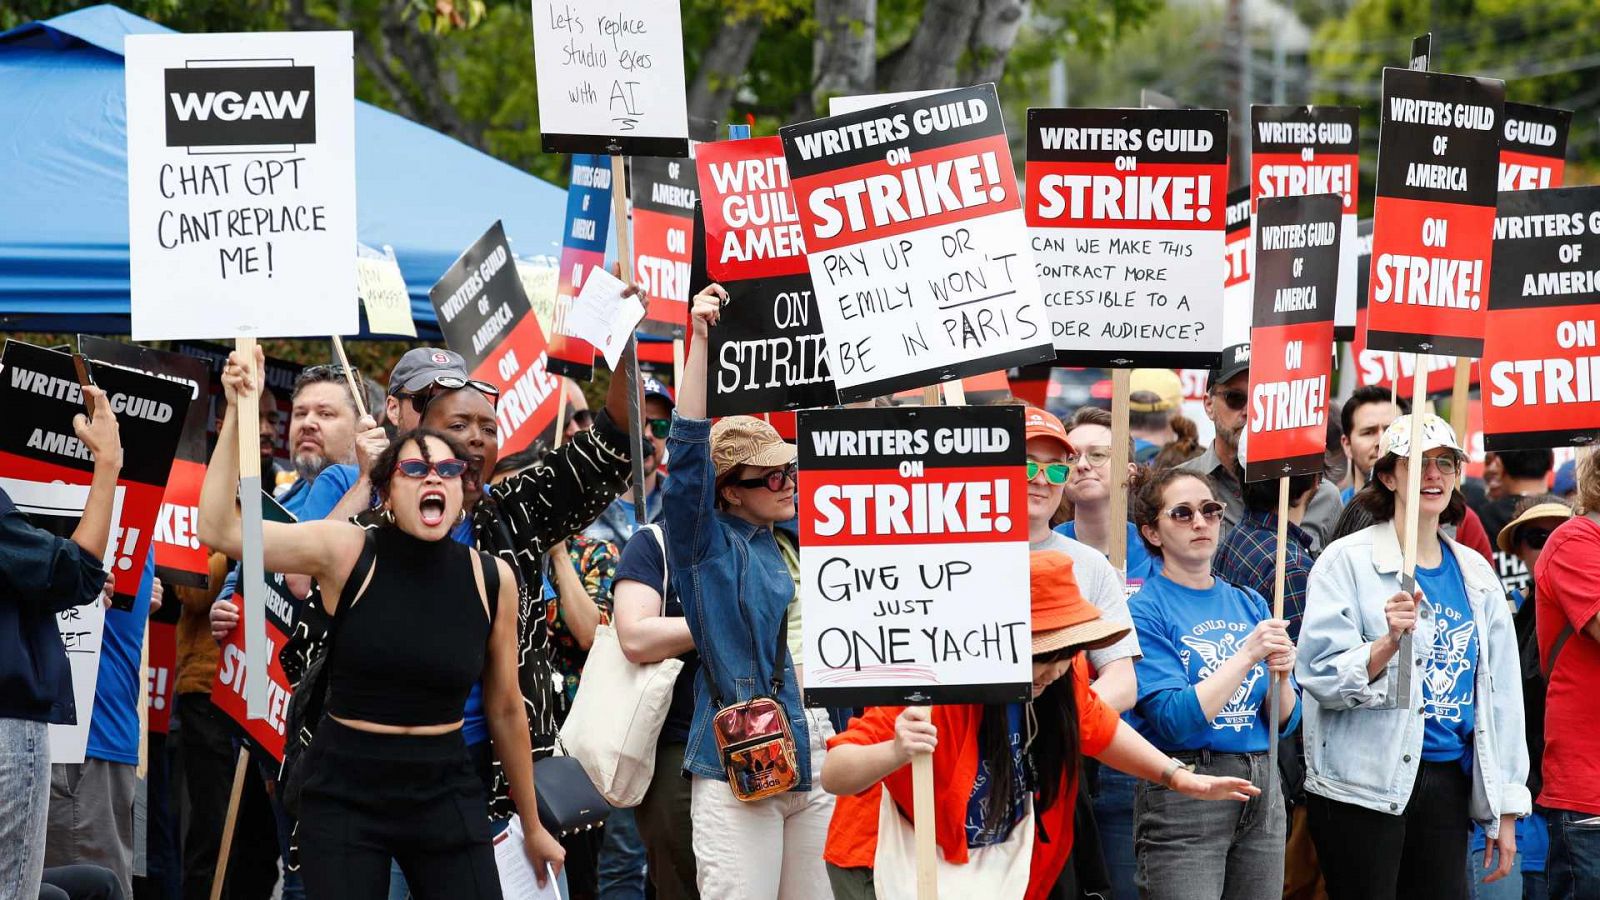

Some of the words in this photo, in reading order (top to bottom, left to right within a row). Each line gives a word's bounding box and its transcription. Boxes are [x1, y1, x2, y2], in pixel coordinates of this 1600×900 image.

[598, 12, 647, 52] replace
[170, 90, 310, 121] WGAW
[569, 80, 597, 104] with
[609, 79, 644, 115] AI
[1390, 97, 1451, 128] WRITERS
[1454, 103, 1495, 131] GUILD
[795, 114, 907, 161] WRITERS
[913, 98, 988, 135] GUILD
[1040, 127, 1142, 151] WRITERS
[1146, 129, 1213, 152] GUILD
[1258, 122, 1317, 143] WRITERS
[1318, 123, 1352, 144] GUILD
[1504, 119, 1557, 147] GUILD
[886, 146, 911, 166] ON
[1301, 147, 1314, 162] ON
[1433, 136, 1447, 156] OF
[159, 163, 232, 199] CHAT
[244, 158, 306, 196] GPT
[668, 162, 680, 180] OF
[709, 157, 789, 194] WRIT
[1115, 156, 1136, 171] ON
[1405, 162, 1467, 192] AMERICA
[652, 182, 696, 209] AMERICA
[722, 191, 799, 229] GUIL
[808, 151, 1006, 239] STRIKE!
[1038, 174, 1212, 223] STRIKE!
[667, 228, 685, 254] ON
[720, 225, 808, 264] AMER
[1032, 236, 1065, 252] CAN
[1075, 239, 1100, 254] WE
[1108, 240, 1152, 255] MAKE
[1159, 241, 1193, 257] THIS
[1262, 224, 1307, 251] WRITERS
[1307, 222, 1335, 247] GUILD
[1422, 217, 1447, 247] ON
[823, 247, 870, 285] PAY
[883, 240, 913, 271] UP
[942, 228, 975, 258] OR
[1293, 258, 1303, 278] OF
[1559, 244, 1582, 263] OF
[440, 271, 483, 323] WRITERS
[479, 245, 507, 283] GUILD
[839, 282, 913, 320] EMILY
[928, 253, 1017, 302] WON'T
[1124, 266, 1167, 281] MORE
[1374, 253, 1483, 311] STRIKE!
[477, 295, 490, 316] OF
[773, 291, 811, 329] ON
[1044, 290, 1137, 308] CCESSIBLE
[1147, 292, 1168, 307] TO
[1176, 295, 1191, 312] A
[1273, 286, 1317, 313] AMERICA
[471, 302, 513, 355] AMERICA
[839, 337, 876, 376] BE
[902, 322, 928, 356] IN
[943, 304, 1038, 349] PARIS
[1101, 321, 1205, 342] AUDIENCE?
[1556, 320, 1596, 349] ON
[497, 349, 520, 382] ON
[717, 333, 834, 394] STRIK
[1285, 340, 1302, 370] ON
[110, 392, 173, 423] GUILD
[1251, 375, 1326, 433] STRIKE!
[812, 429, 930, 457] WRITERS
[934, 427, 1010, 454] GUILD
[899, 461, 924, 478] ON
[813, 479, 1012, 536] STRIKE!
[817, 557, 899, 601] GIVE
[919, 561, 972, 591] UP
[873, 599, 933, 616] JUST
[1445, 607, 1462, 621] OF
[1193, 620, 1226, 636] GUILD
[1228, 622, 1248, 632] OF
[817, 625, 916, 672] ONE
[920, 622, 1027, 664] YACHT
[1224, 716, 1250, 724] WEST
